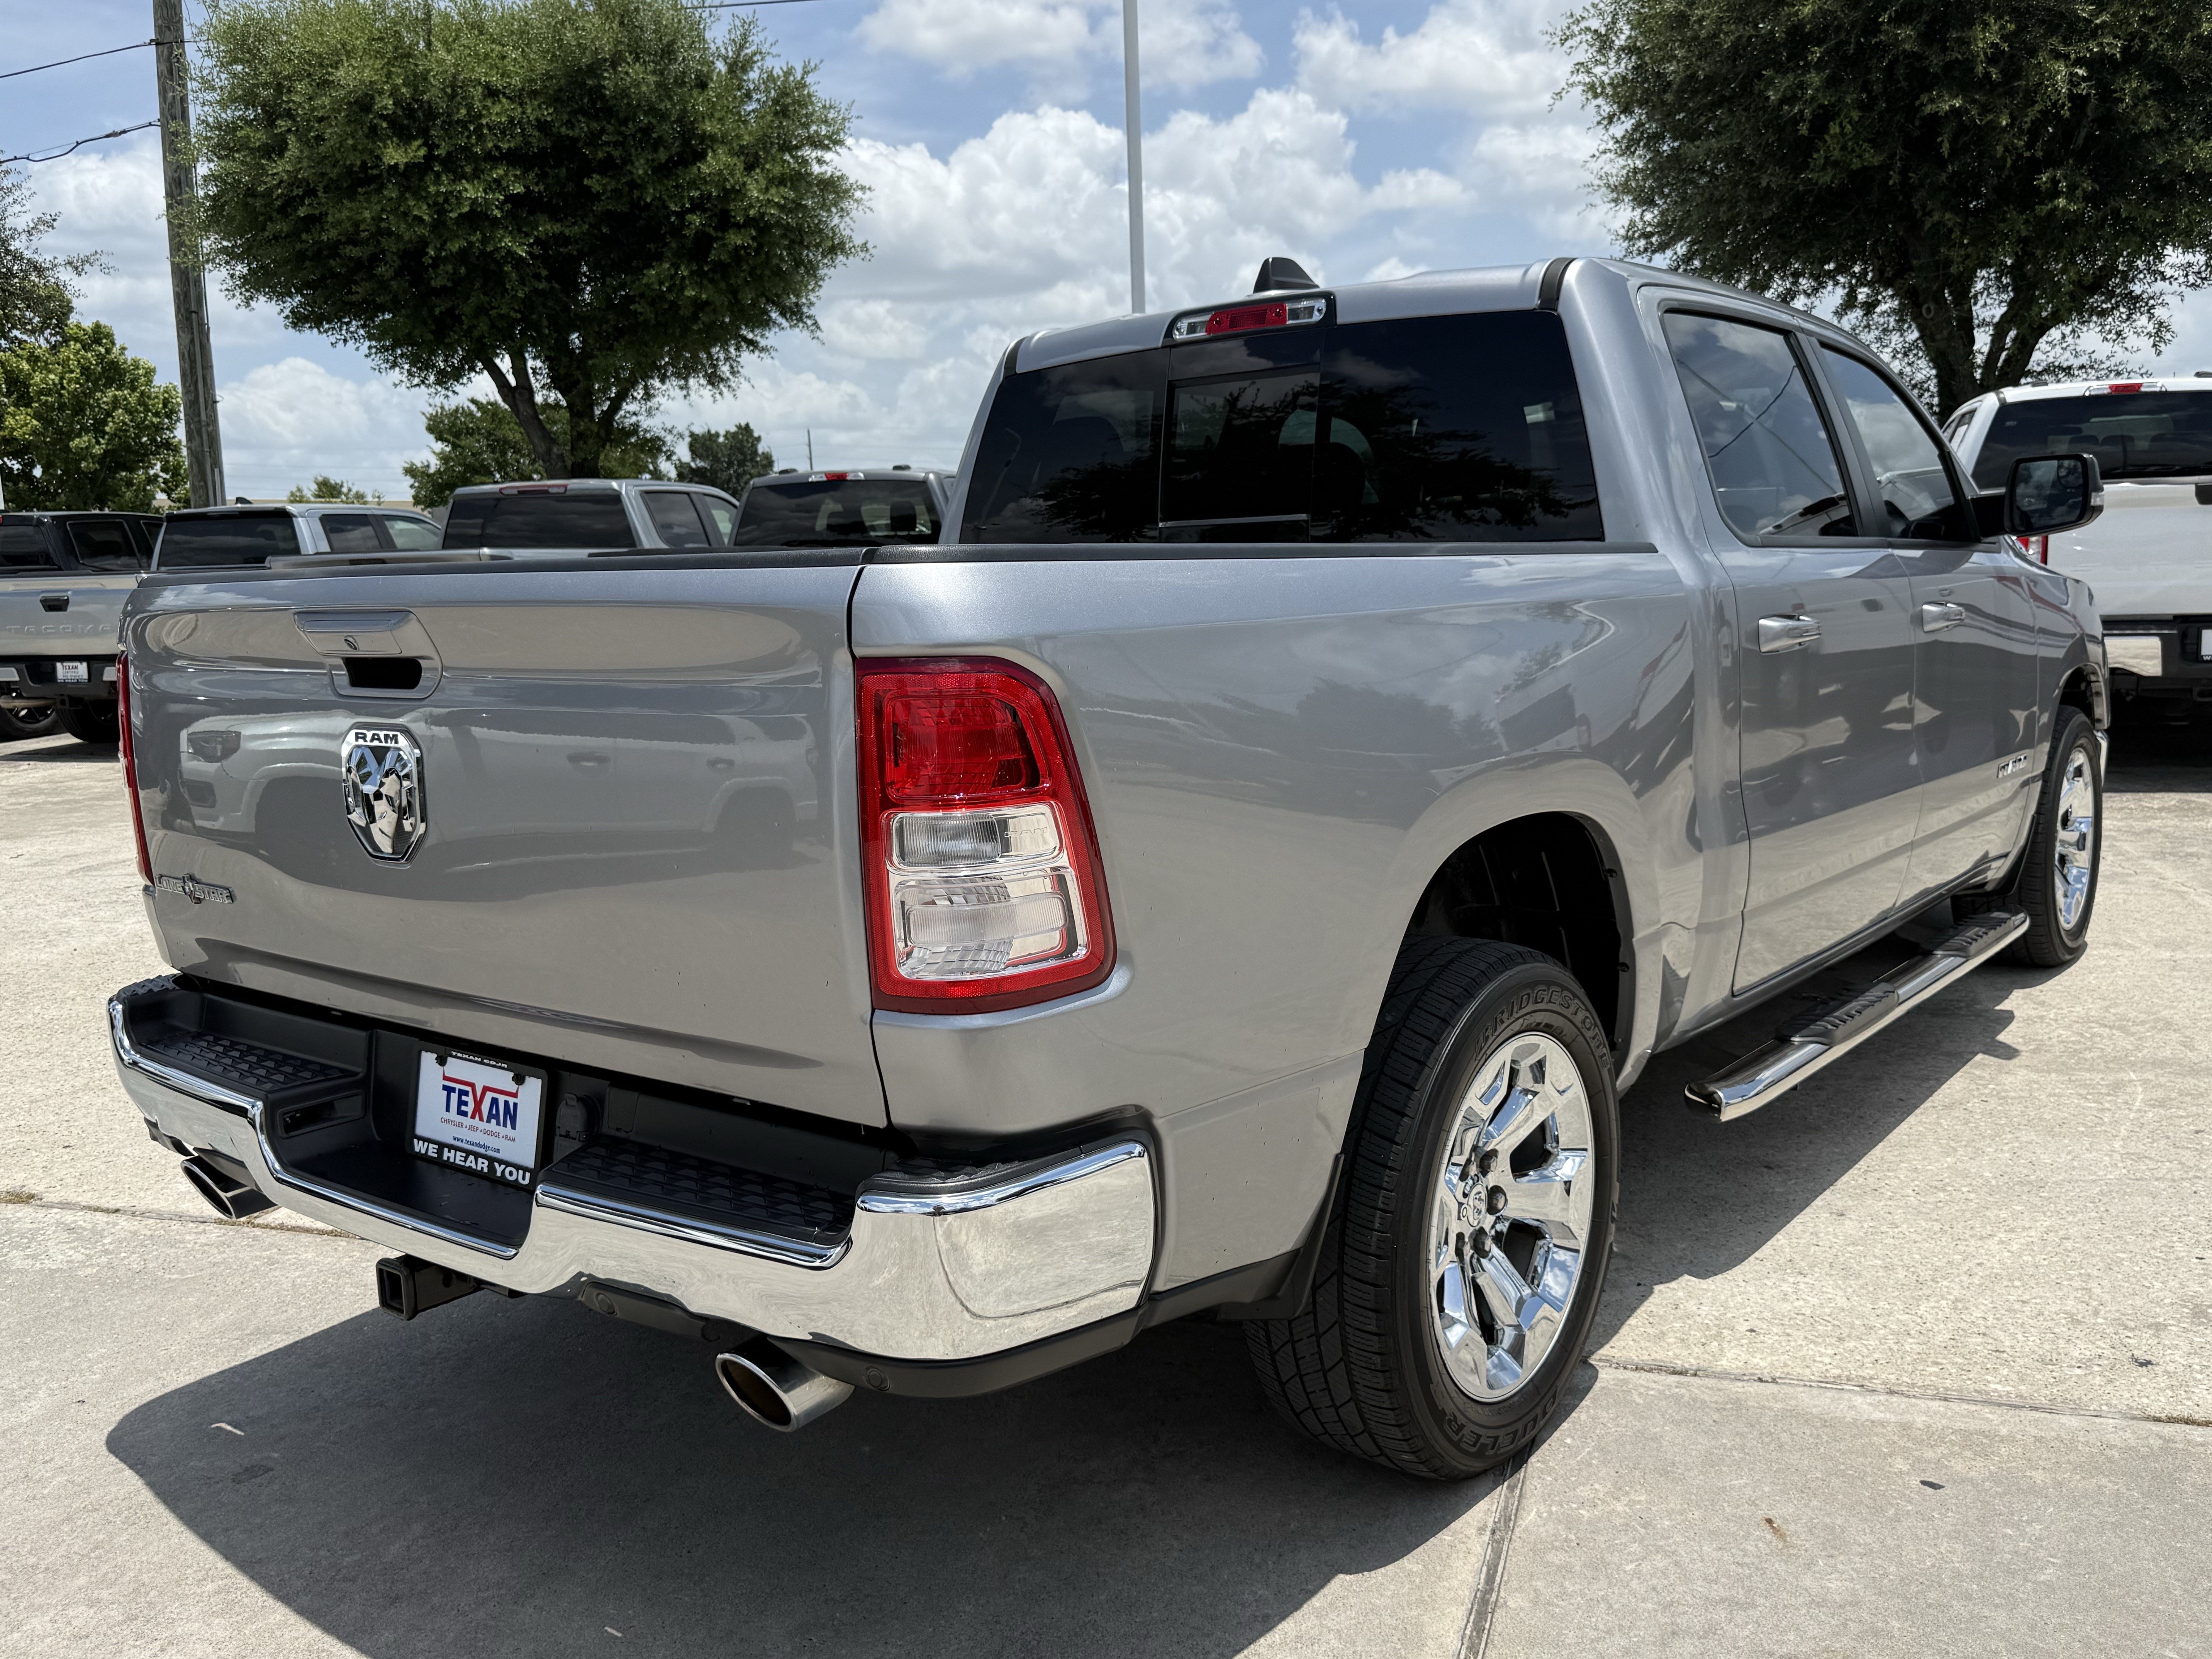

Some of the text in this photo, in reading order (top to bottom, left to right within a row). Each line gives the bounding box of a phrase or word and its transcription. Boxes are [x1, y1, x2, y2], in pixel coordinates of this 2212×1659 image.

[6, 624, 112, 634] TACOMA
[355, 732, 399, 744] RAM
[1004, 827, 1048, 837] RAM
[1474, 984, 1610, 1070] BRIDGESTONE
[451, 1051, 508, 1068] TEXAN CDJR
[442, 1083, 519, 1130] TEXAN
[441, 1117, 464, 1128] CHRYSLER
[483, 1128, 500, 1139] DODGE
[505, 1134, 516, 1142] RAM
[453, 1135, 501, 1154] www.texandodge.com
[413, 1139, 531, 1185] WE HEAR YOU
[1443, 1387, 1559, 1455] DUELER
